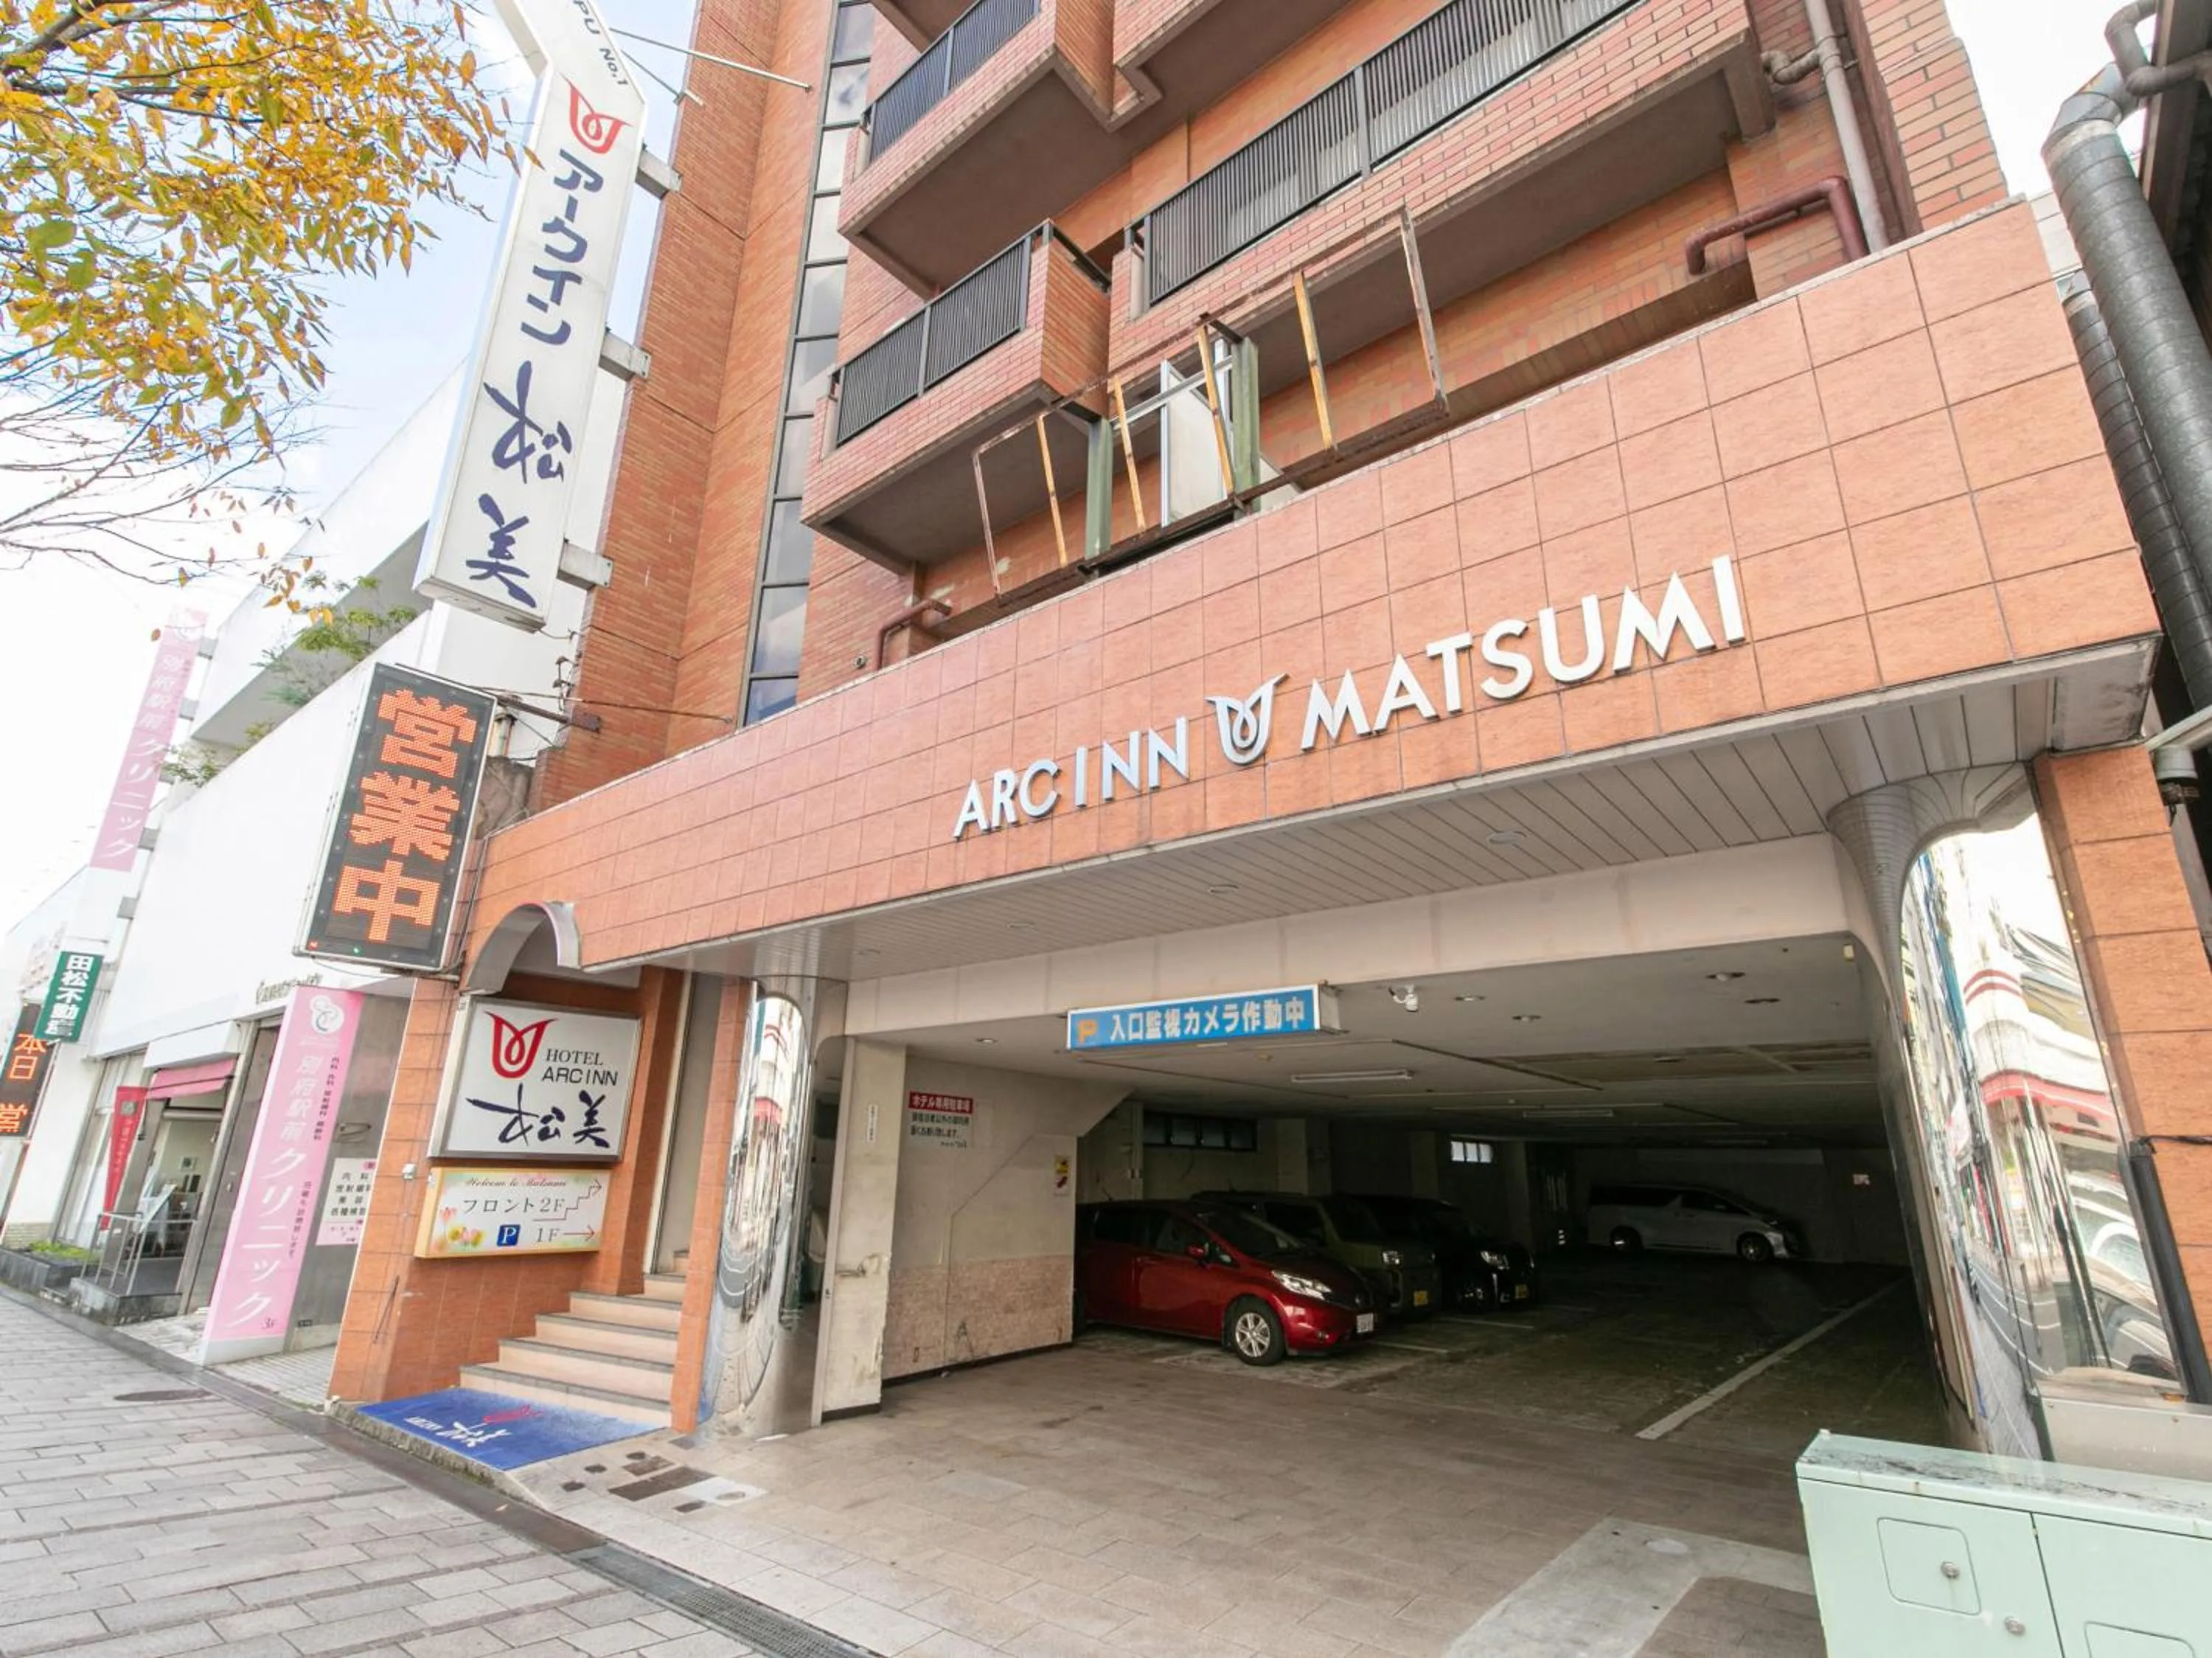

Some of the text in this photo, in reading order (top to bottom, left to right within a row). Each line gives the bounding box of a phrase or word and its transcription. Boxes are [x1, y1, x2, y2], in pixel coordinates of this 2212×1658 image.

[599, 48, 628, 85] No.1
[1301, 554, 1745, 752] MATSUMI
[333, 688, 478, 942] 営業中
[1077, 996, 1305, 1043] P 入口監視カメラ作動中
[9, 1034, 47, 1081] 本日
[546, 1048, 604, 1066] HOTEL
[465, 1083, 611, 1148] 松美
[224, 1055, 323, 1328] 別府駅前クリニック
[502, 1227, 560, 1244] P 1F
